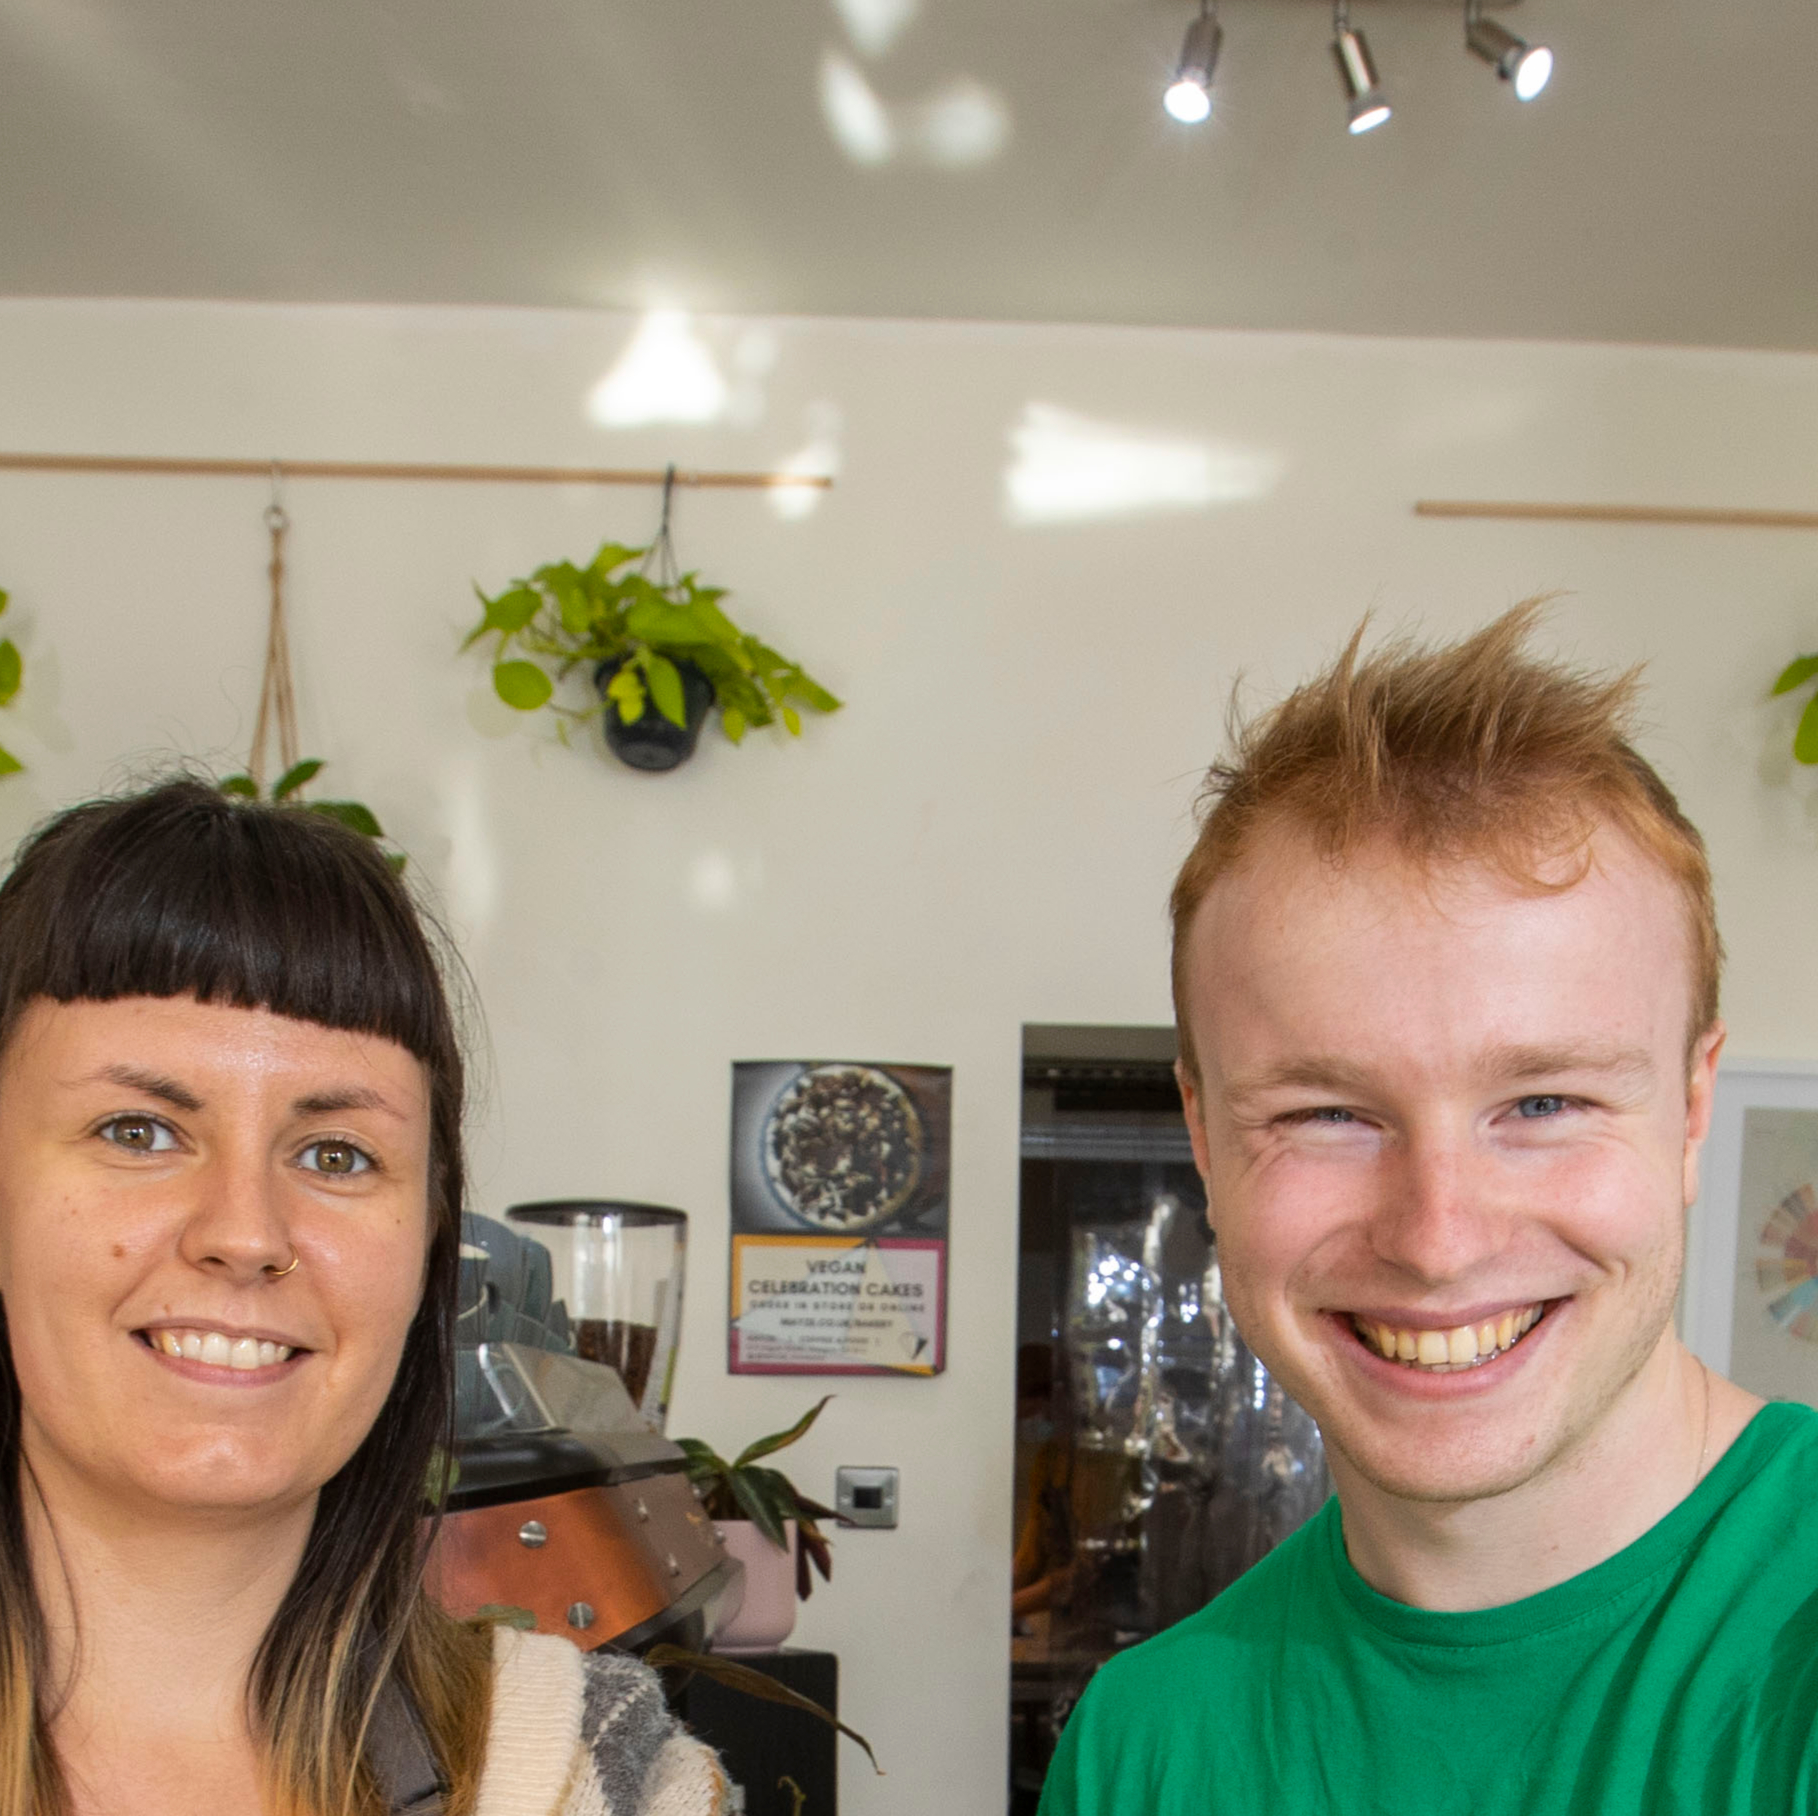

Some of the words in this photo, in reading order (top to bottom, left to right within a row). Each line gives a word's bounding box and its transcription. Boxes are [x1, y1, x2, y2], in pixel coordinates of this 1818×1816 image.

[806, 1260, 866, 1274] VEGAN
[748, 1280, 861, 1295] CELEBRATION
[866, 1283, 924, 1297] CAKES
